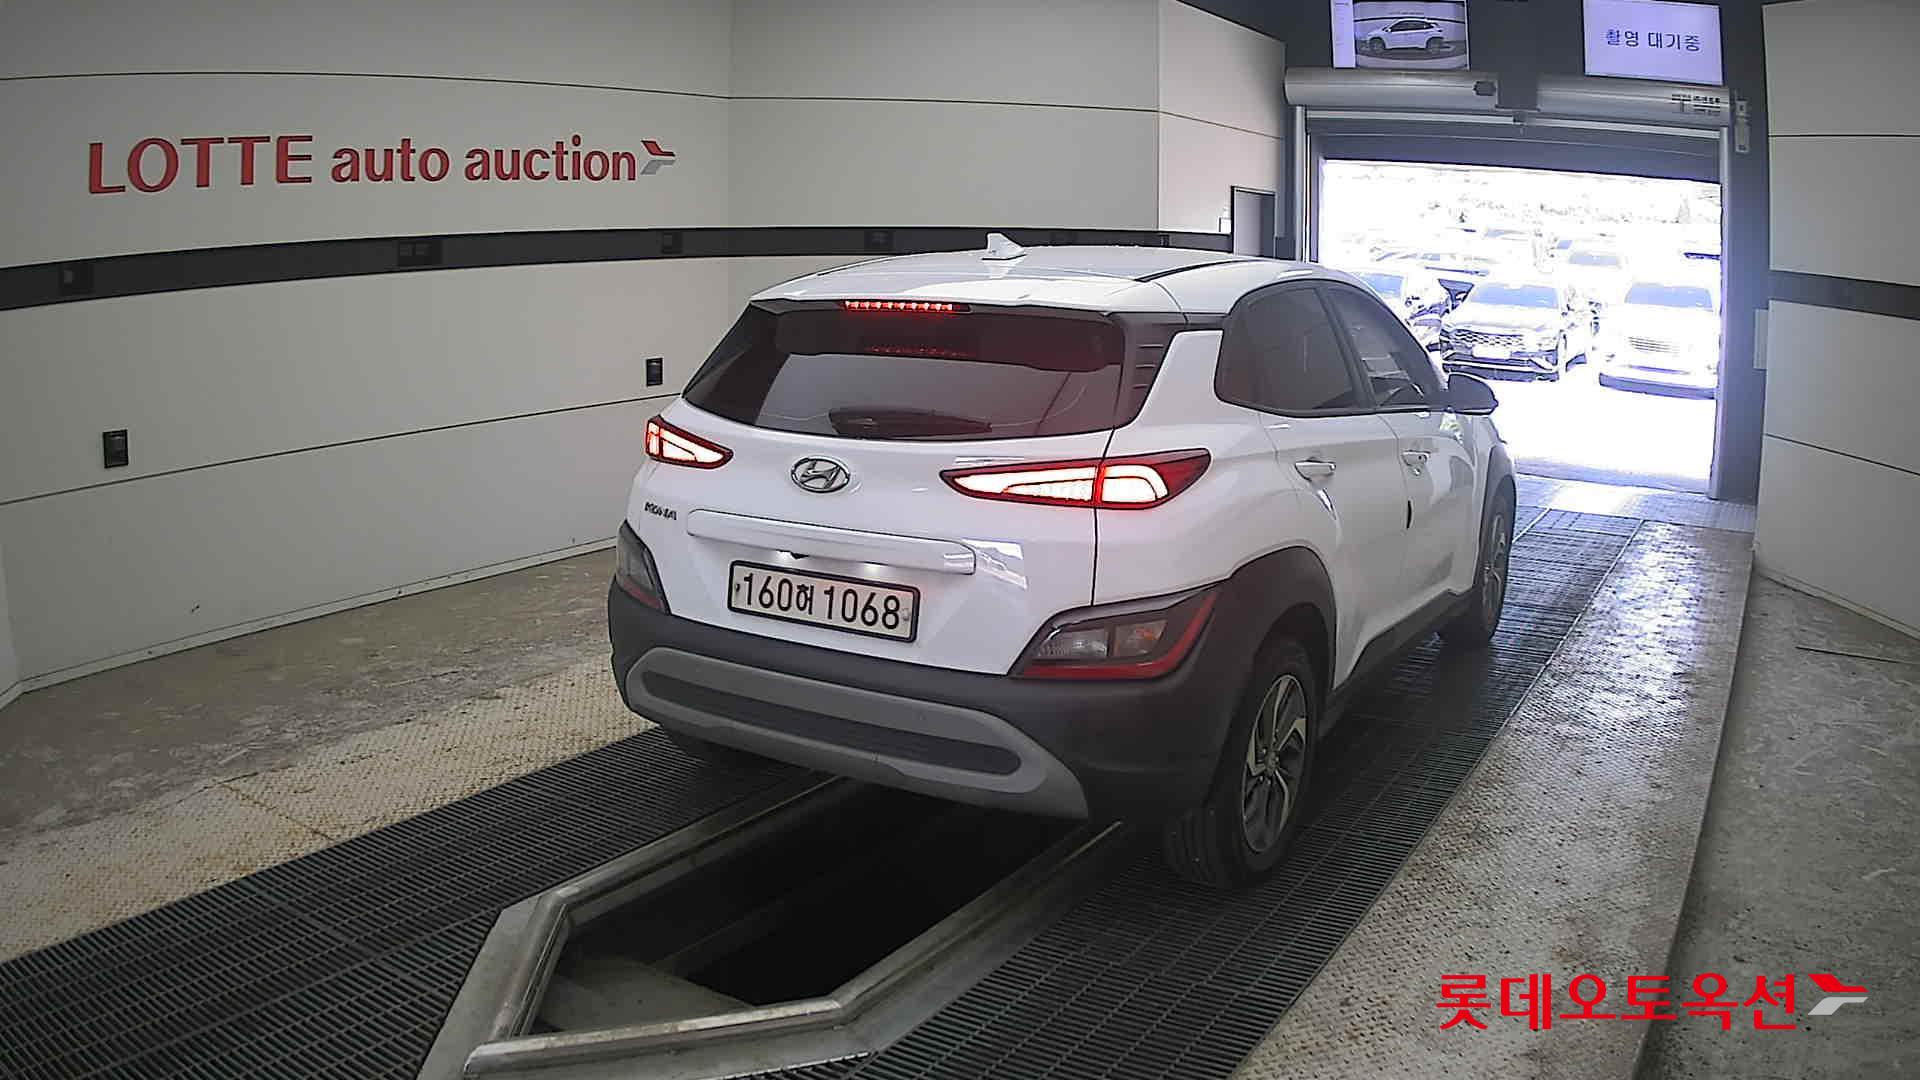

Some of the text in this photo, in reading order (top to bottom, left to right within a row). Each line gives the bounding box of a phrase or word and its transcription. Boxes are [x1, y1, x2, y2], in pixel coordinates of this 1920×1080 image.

[1647, 31, 1701, 52] 대기중
[88, 134, 636, 194] LOTTE auto auction
[743, 573, 901, 630] 160허 1068
